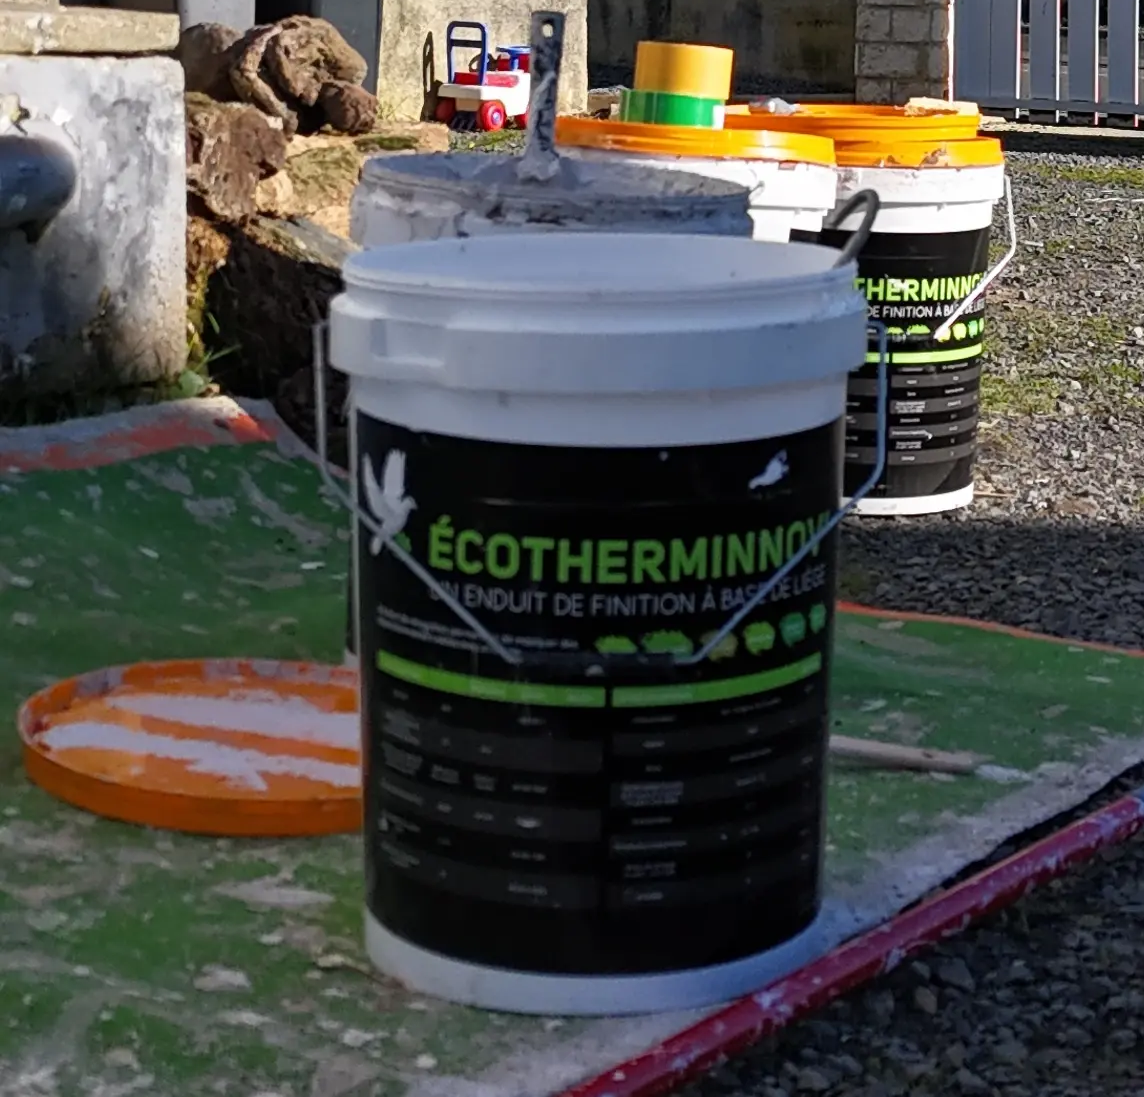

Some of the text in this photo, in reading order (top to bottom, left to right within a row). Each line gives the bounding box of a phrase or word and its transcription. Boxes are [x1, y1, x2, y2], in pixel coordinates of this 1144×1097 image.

[883, 304, 933, 318] FINITION
[464, 583, 548, 617] ENDUIT
[553, 592, 584, 617] DE
[589, 591, 697, 617] FINITION
[701, 584, 718, 611] À
